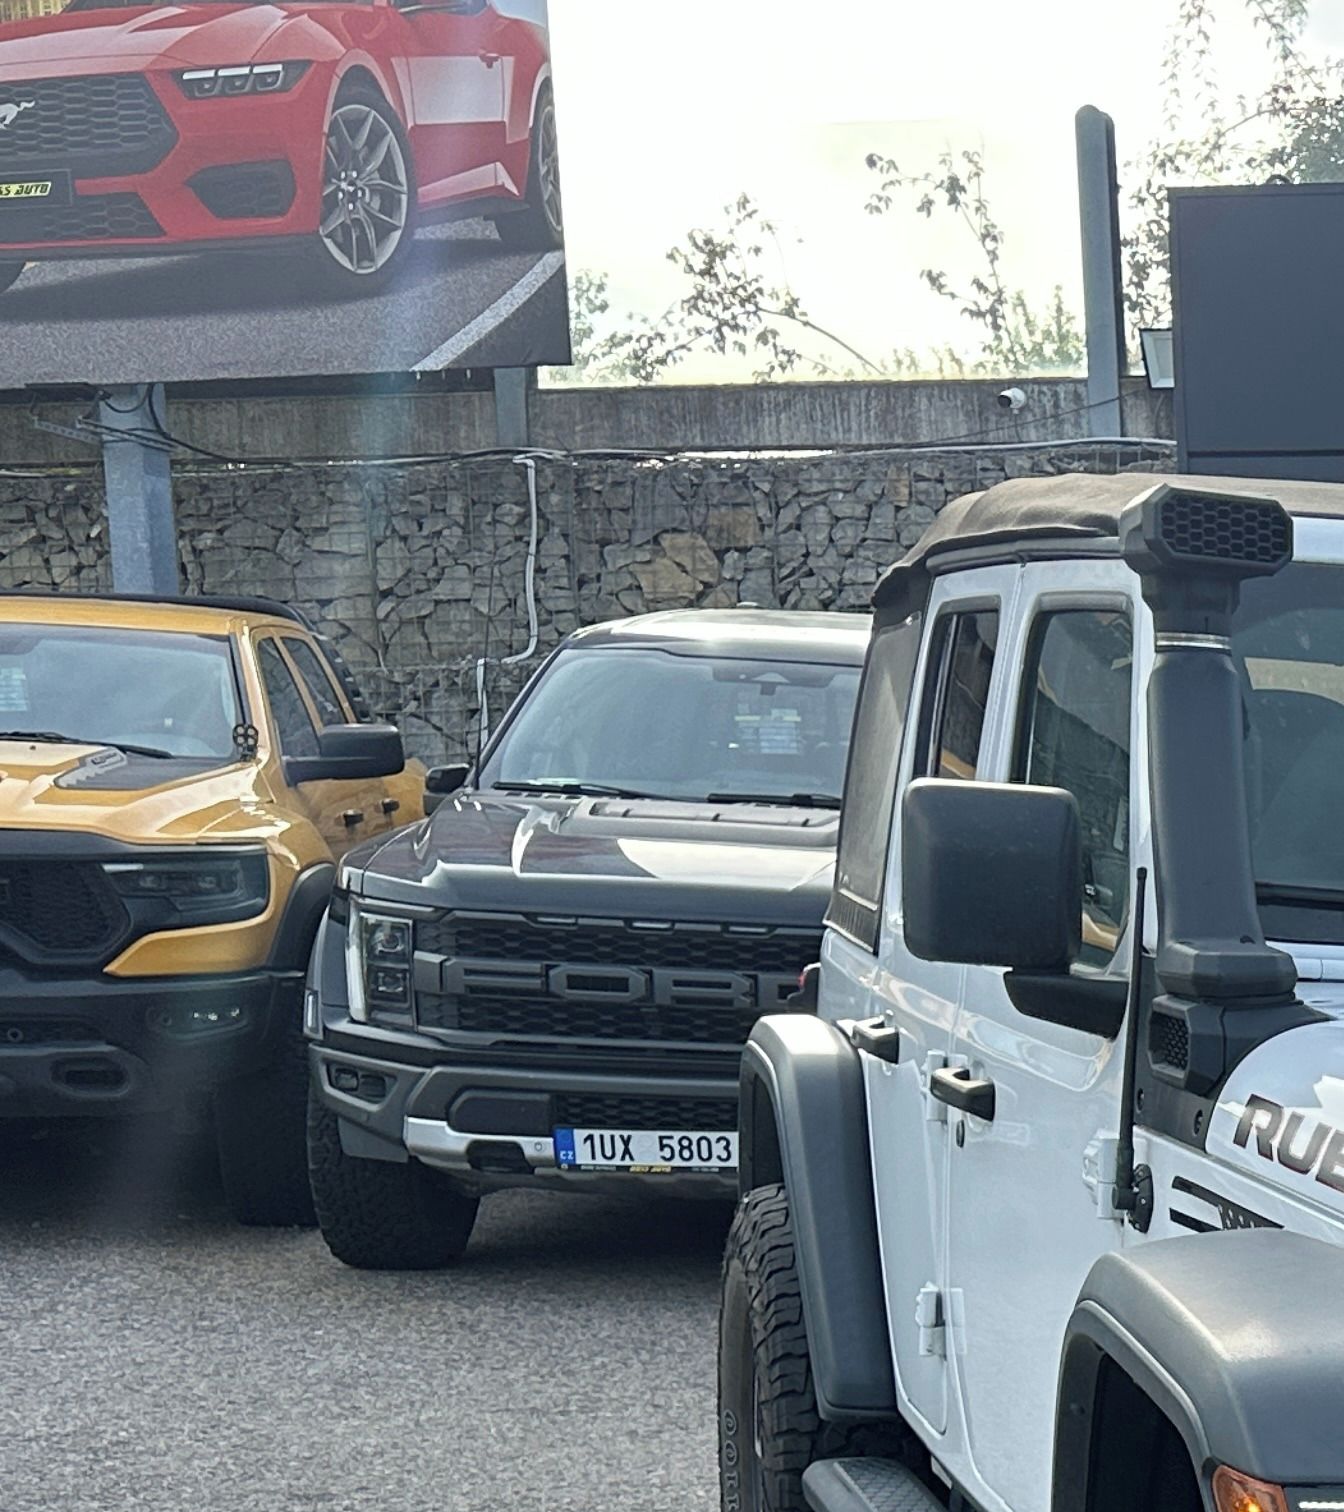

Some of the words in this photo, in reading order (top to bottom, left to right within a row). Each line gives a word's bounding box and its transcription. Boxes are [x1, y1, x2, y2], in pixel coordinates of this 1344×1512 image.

[14, 184, 49, 195] AUTO
[560, 1151, 574, 1160] CZ
[583, 1134, 635, 1162] 1UX
[658, 1135, 732, 1162] 5803
